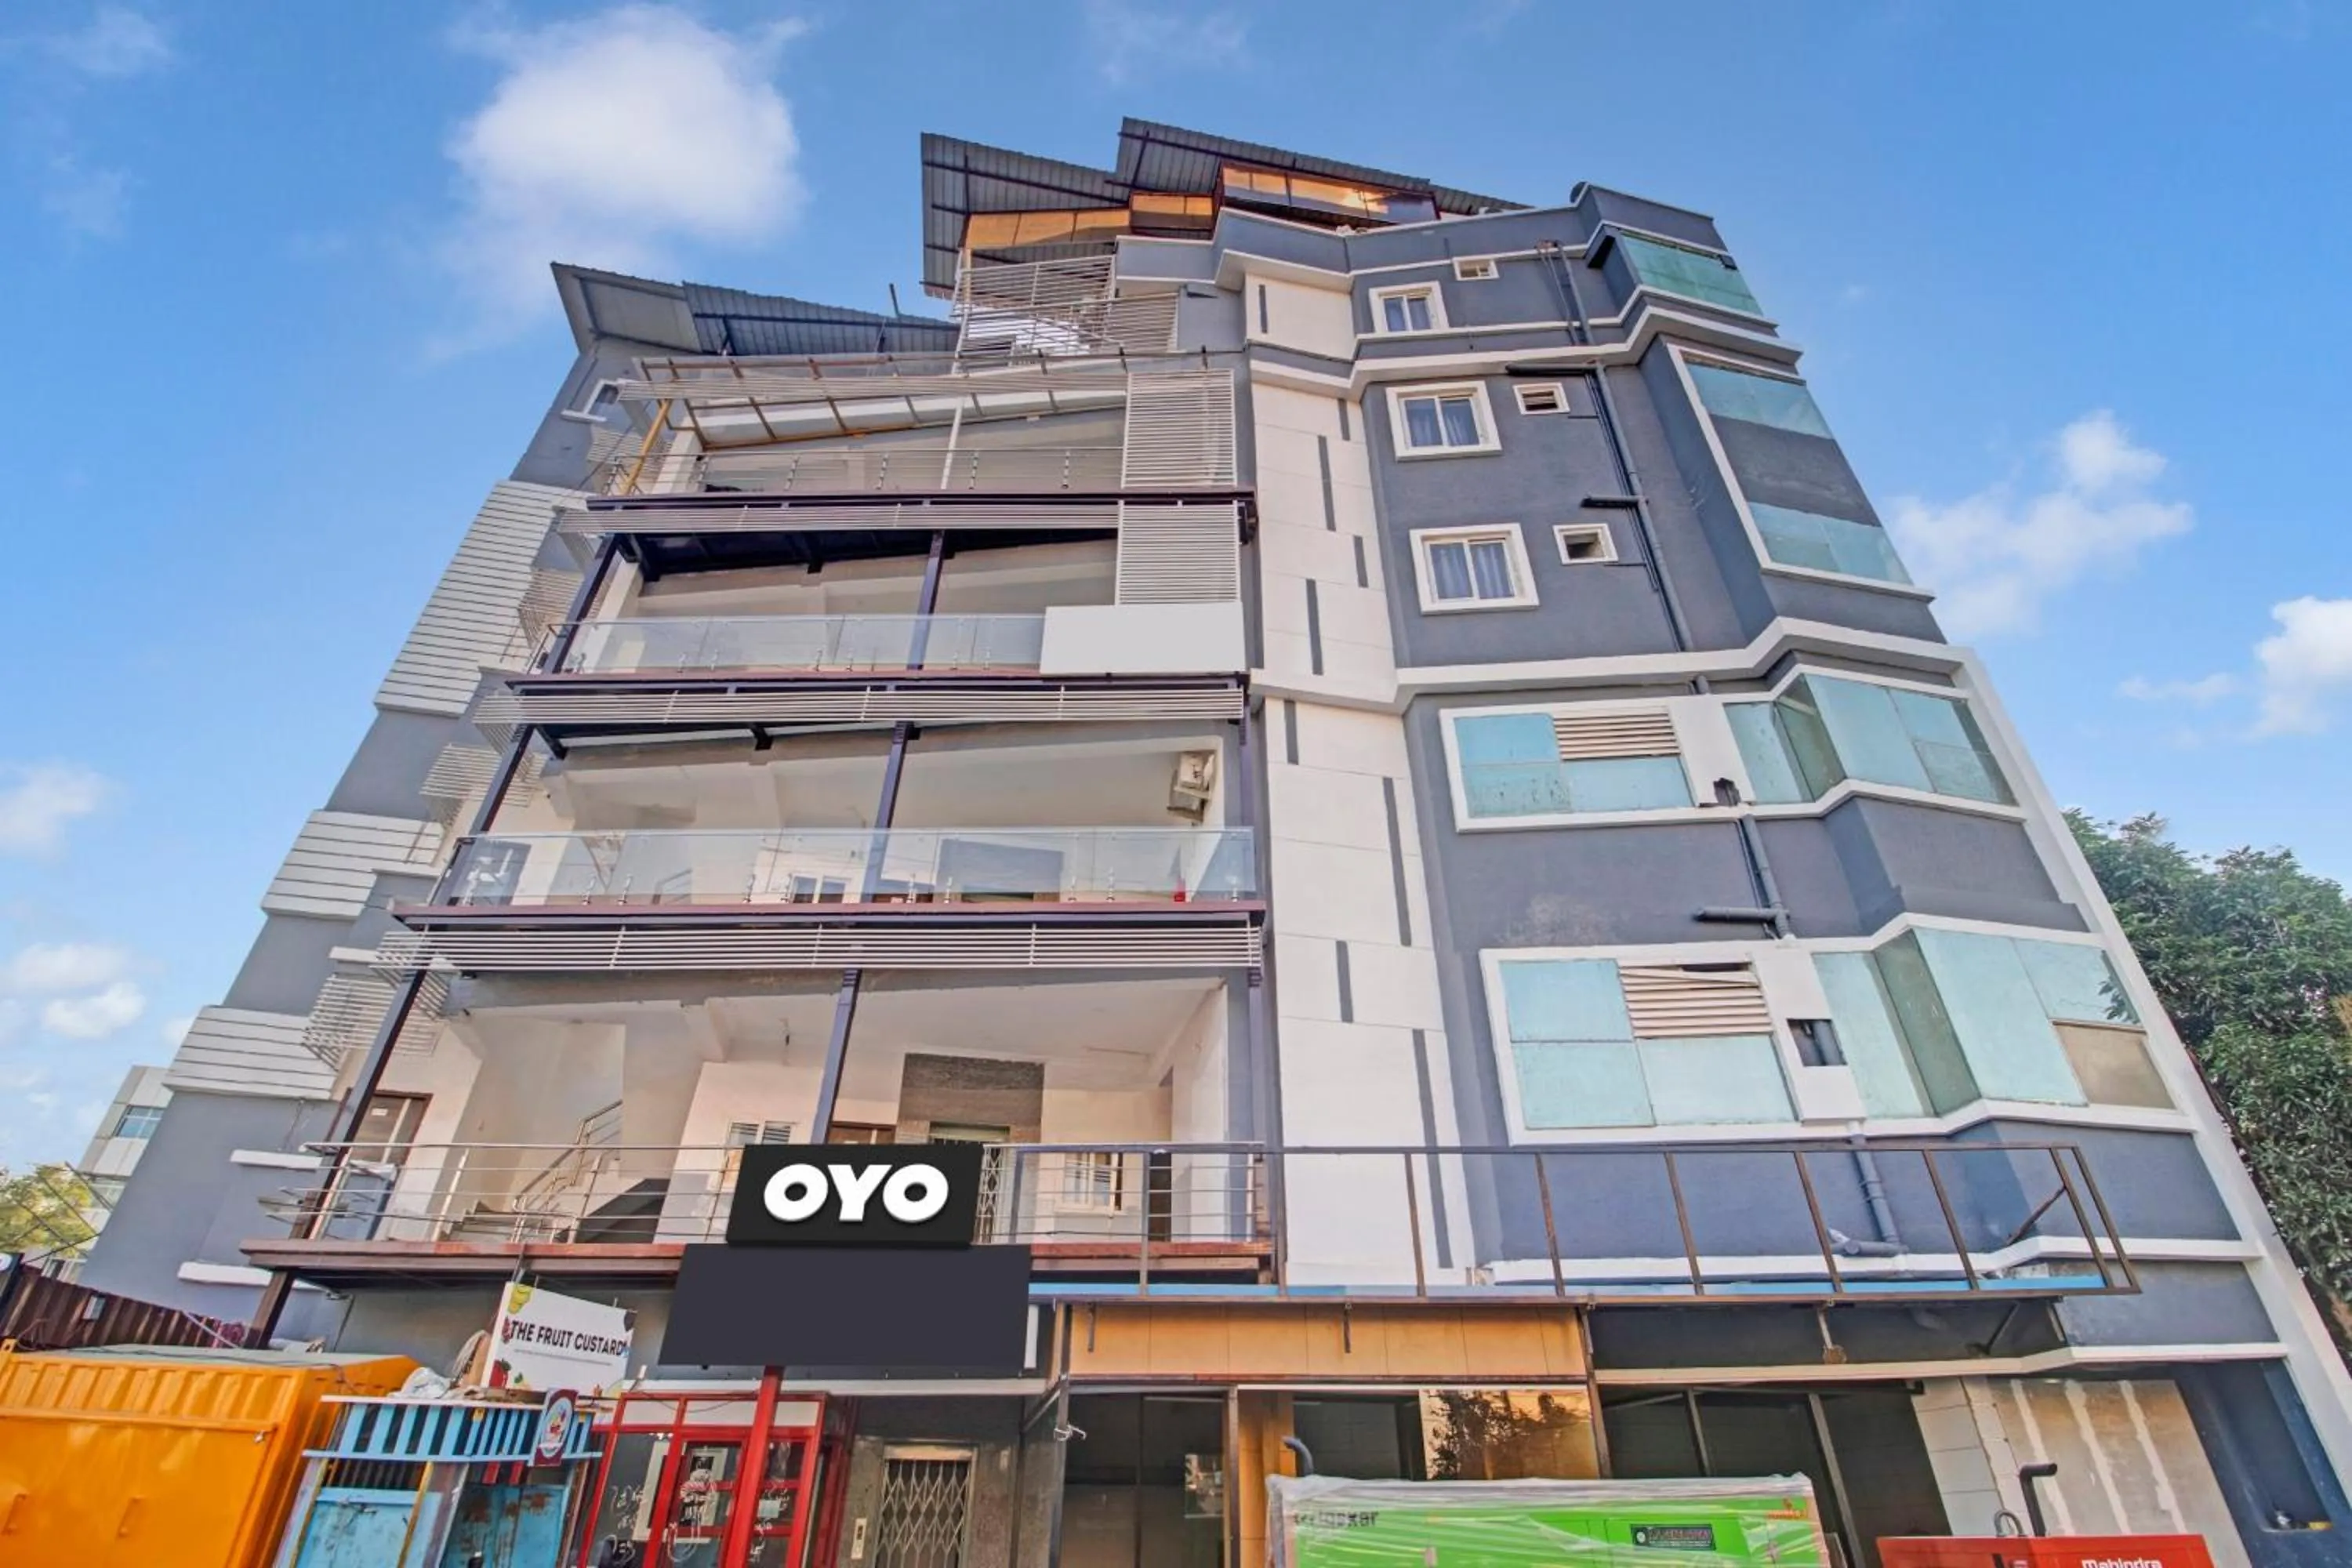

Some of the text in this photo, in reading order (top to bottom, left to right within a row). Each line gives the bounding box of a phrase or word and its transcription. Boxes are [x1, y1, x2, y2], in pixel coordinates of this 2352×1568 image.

[764, 1163, 949, 1223] OYO
[510, 1320, 626, 1356] THE FRUIT CUSTARD
